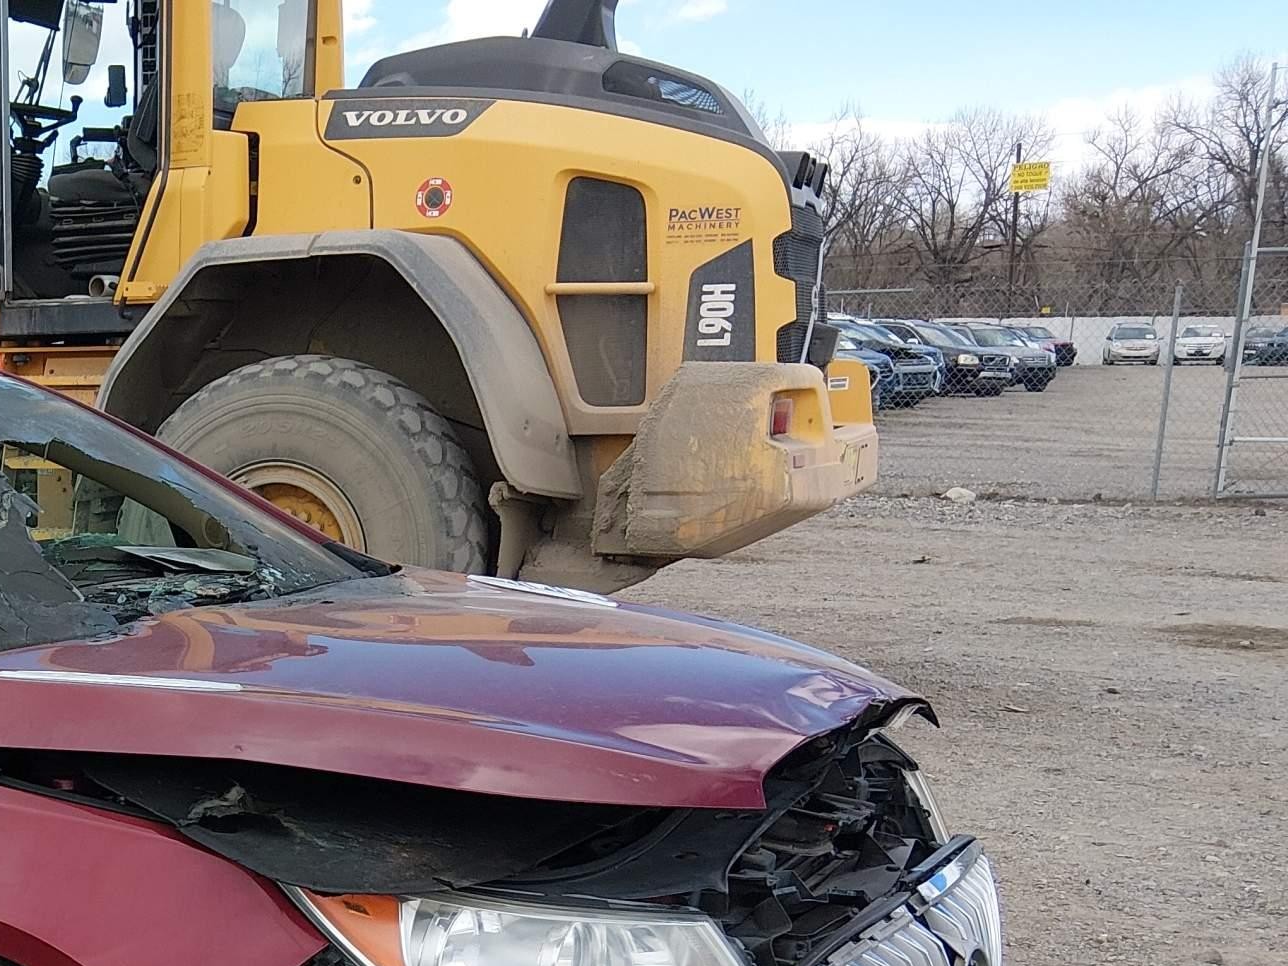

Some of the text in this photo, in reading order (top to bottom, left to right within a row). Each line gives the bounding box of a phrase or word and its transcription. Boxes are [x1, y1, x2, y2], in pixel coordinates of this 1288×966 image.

[342, 109, 468, 127] VOLVO
[667, 221, 741, 231] MACHINERY
[696, 283, 737, 346] L90H
